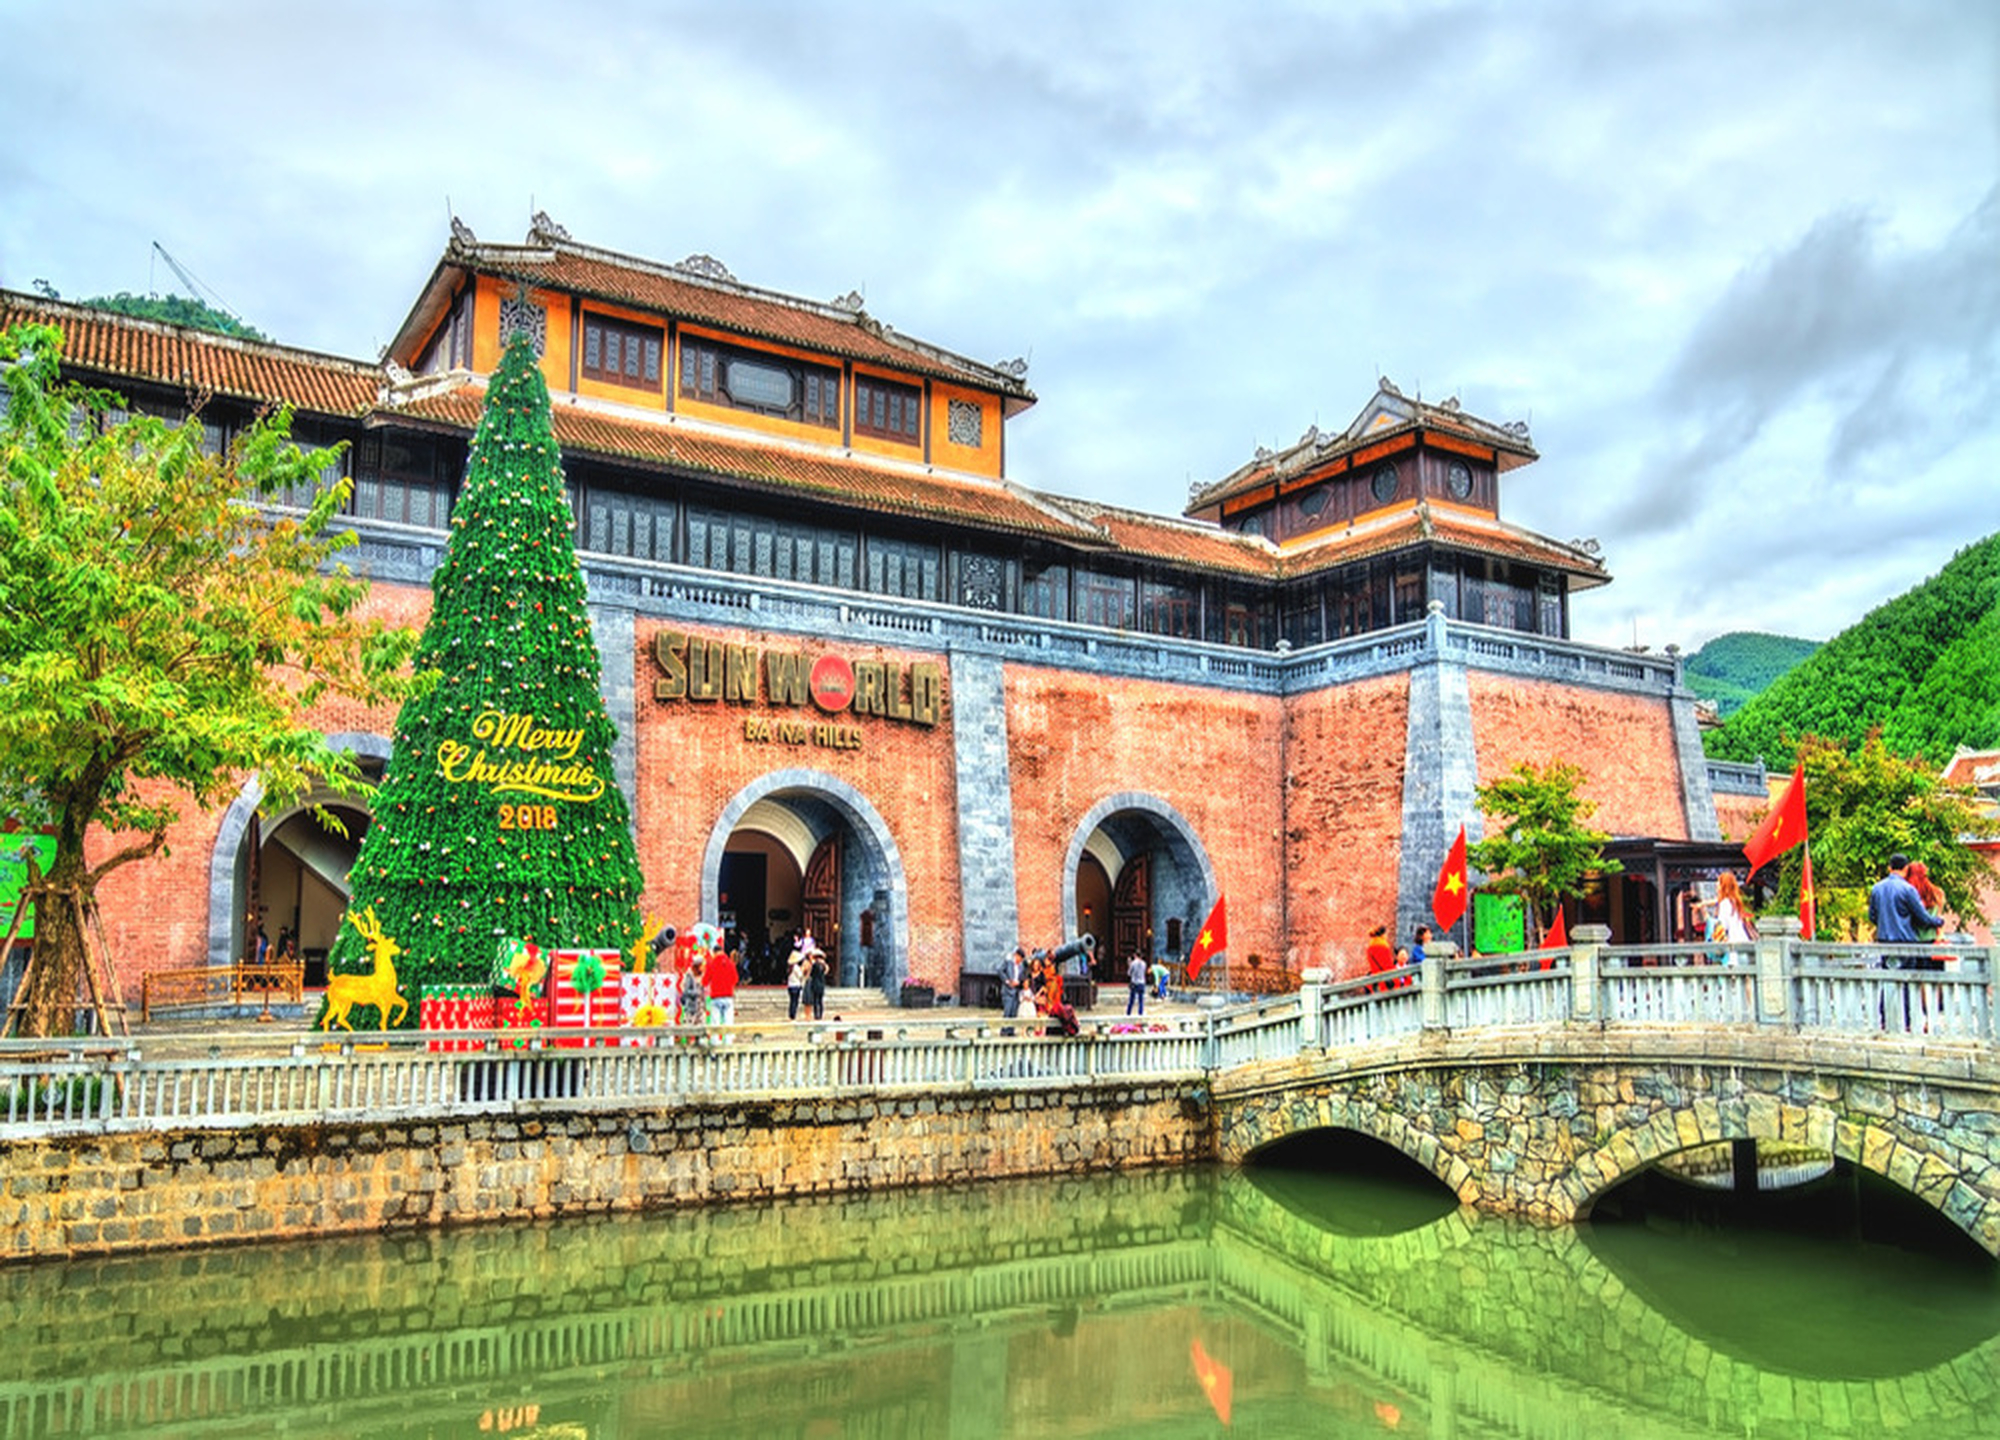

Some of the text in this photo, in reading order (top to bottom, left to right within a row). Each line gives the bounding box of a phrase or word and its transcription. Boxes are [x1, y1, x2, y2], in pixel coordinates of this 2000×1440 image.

[655, 629, 943, 726] SUN WORLD
[472, 711, 585, 760] Merry
[813, 724, 863, 750] HILLS
[437, 739, 606, 802] Christmas
[498, 804, 558, 830] 2018
